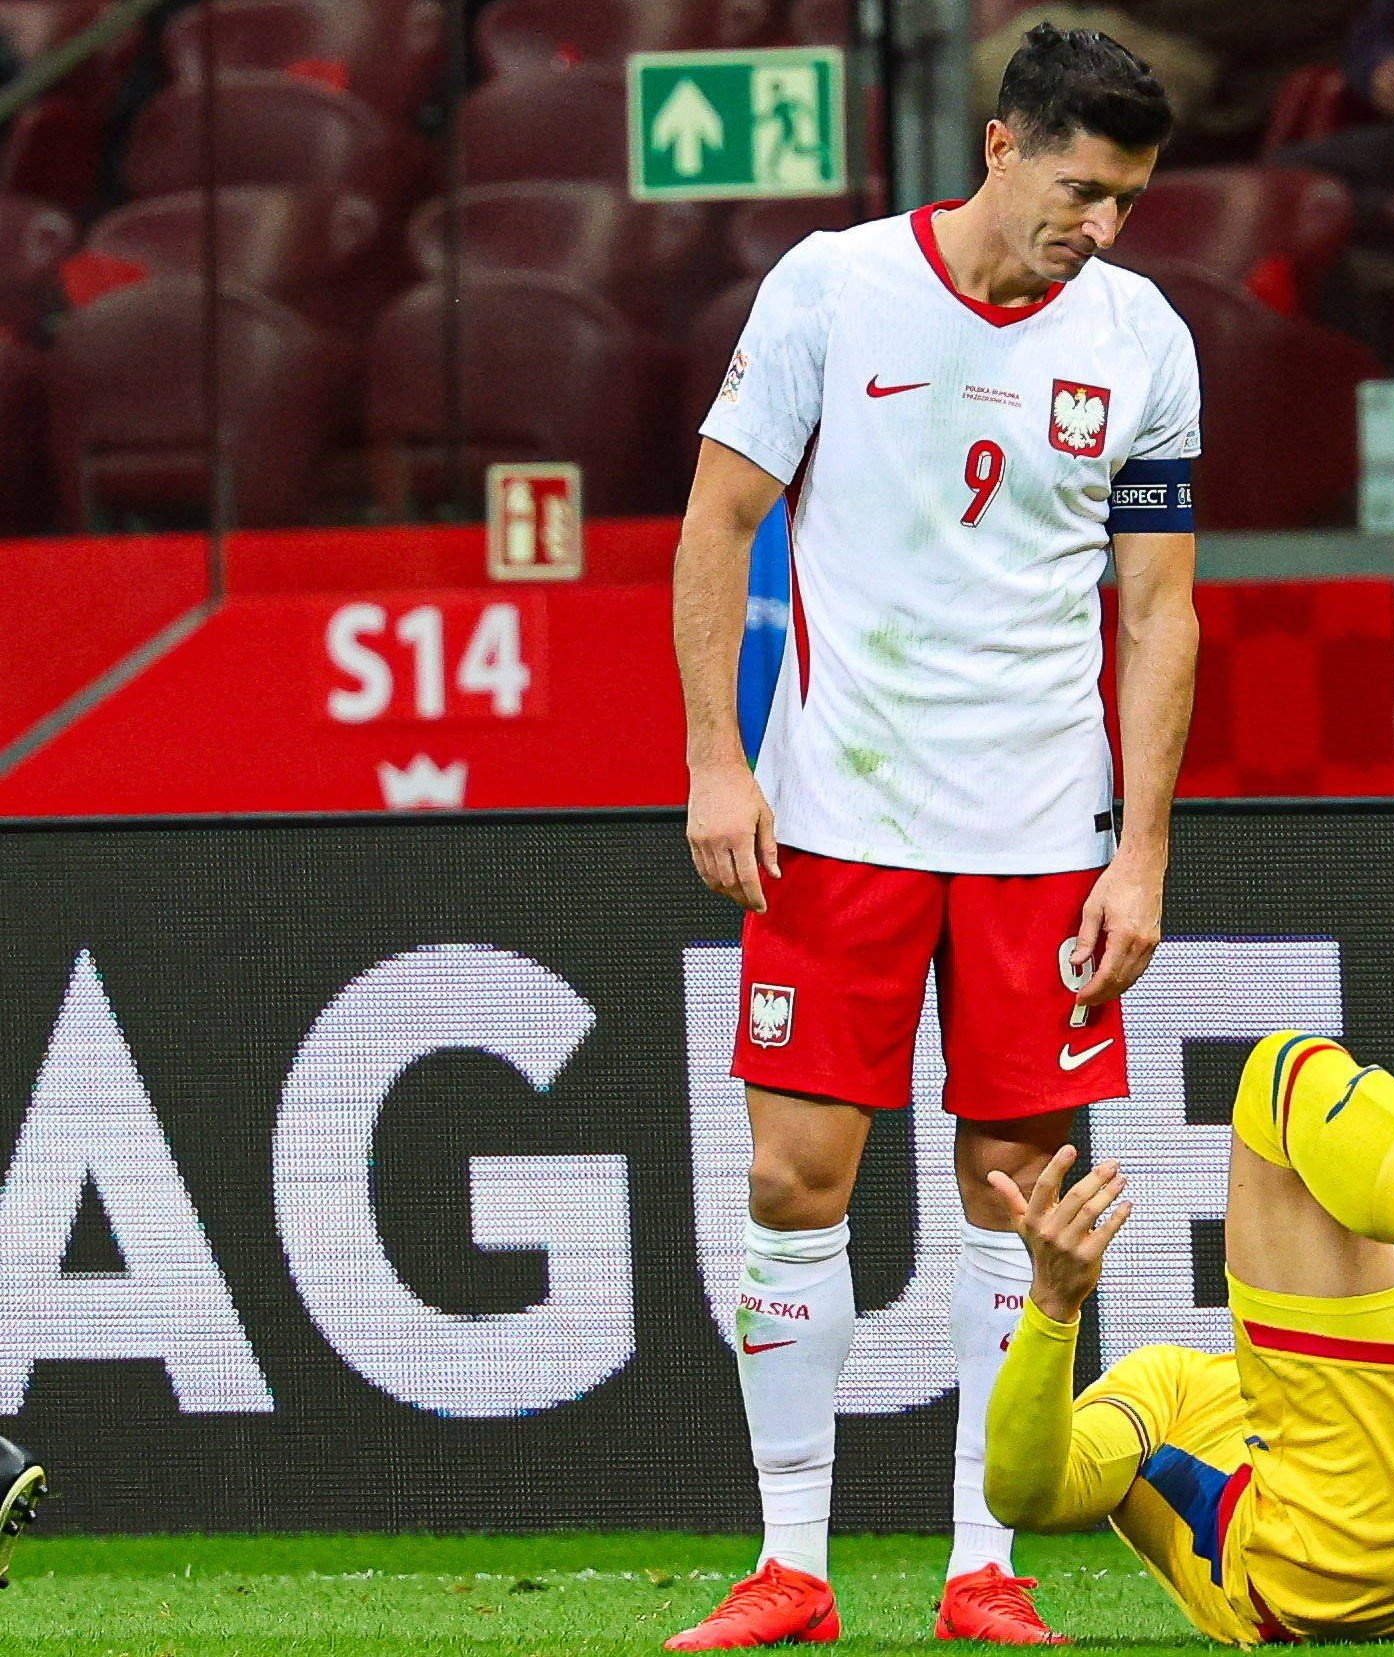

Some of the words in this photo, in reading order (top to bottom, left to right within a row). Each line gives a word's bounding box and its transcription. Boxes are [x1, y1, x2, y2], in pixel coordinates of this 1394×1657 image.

[960, 439, 1006, 528] 9
[325, 602, 532, 724] S14
[740, 1293, 810, 1320] POLSKA
